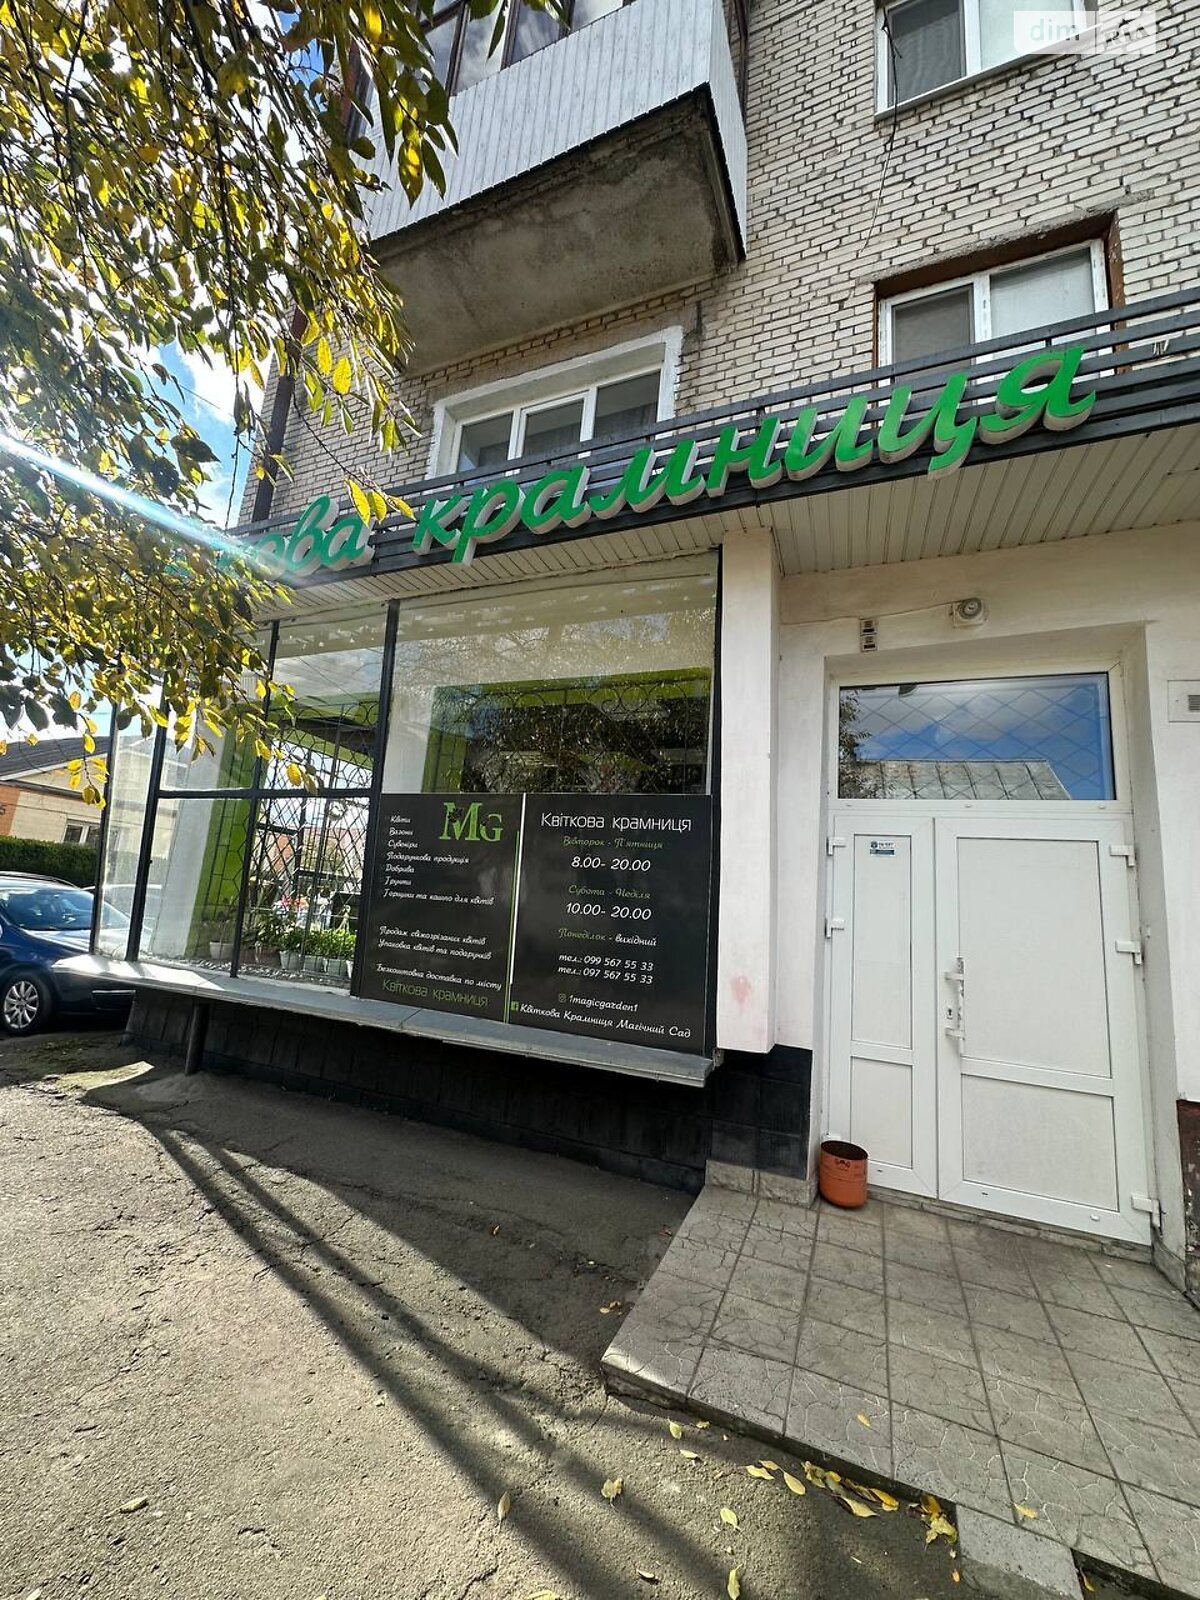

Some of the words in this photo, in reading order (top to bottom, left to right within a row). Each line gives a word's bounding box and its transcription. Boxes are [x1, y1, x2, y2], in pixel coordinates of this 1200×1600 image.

[411, 346, 1097, 567] крамниця
[540, 812, 605, 829] Квіткова
[612, 816, 692, 833] крамниця
[562, 835, 605, 847] Вівторок
[571, 855, 606, 869] 8.00-
[610, 858, 651, 871] 20.00
[454, 894, 468, 903] для
[568, 884, 605, 896] Субота
[565, 902, 606, 916] 10.00-
[610, 905, 652, 920] 20.00
[615, 933, 658, 947] вихідний
[584, 955, 602, 966] 099
[604, 957, 622, 969] 567
[624, 960, 638, 971] 55
[640, 961, 655, 972] 33
[464, 978, 475, 986] по
[583, 967, 601, 978] 097
[603, 970, 621, 980] 567
[623, 972, 637, 984] 55
[639, 974, 654, 985] 33
[382, 979, 429, 997] Квіткова
[432, 989, 489, 1007] крамниця
[519, 1003, 562, 1019] Квіткова
[563, 1009, 614, 1028] Крамниця
[616, 1018, 665, 1035] Магічний
[668, 1024, 691, 1039] Сад
